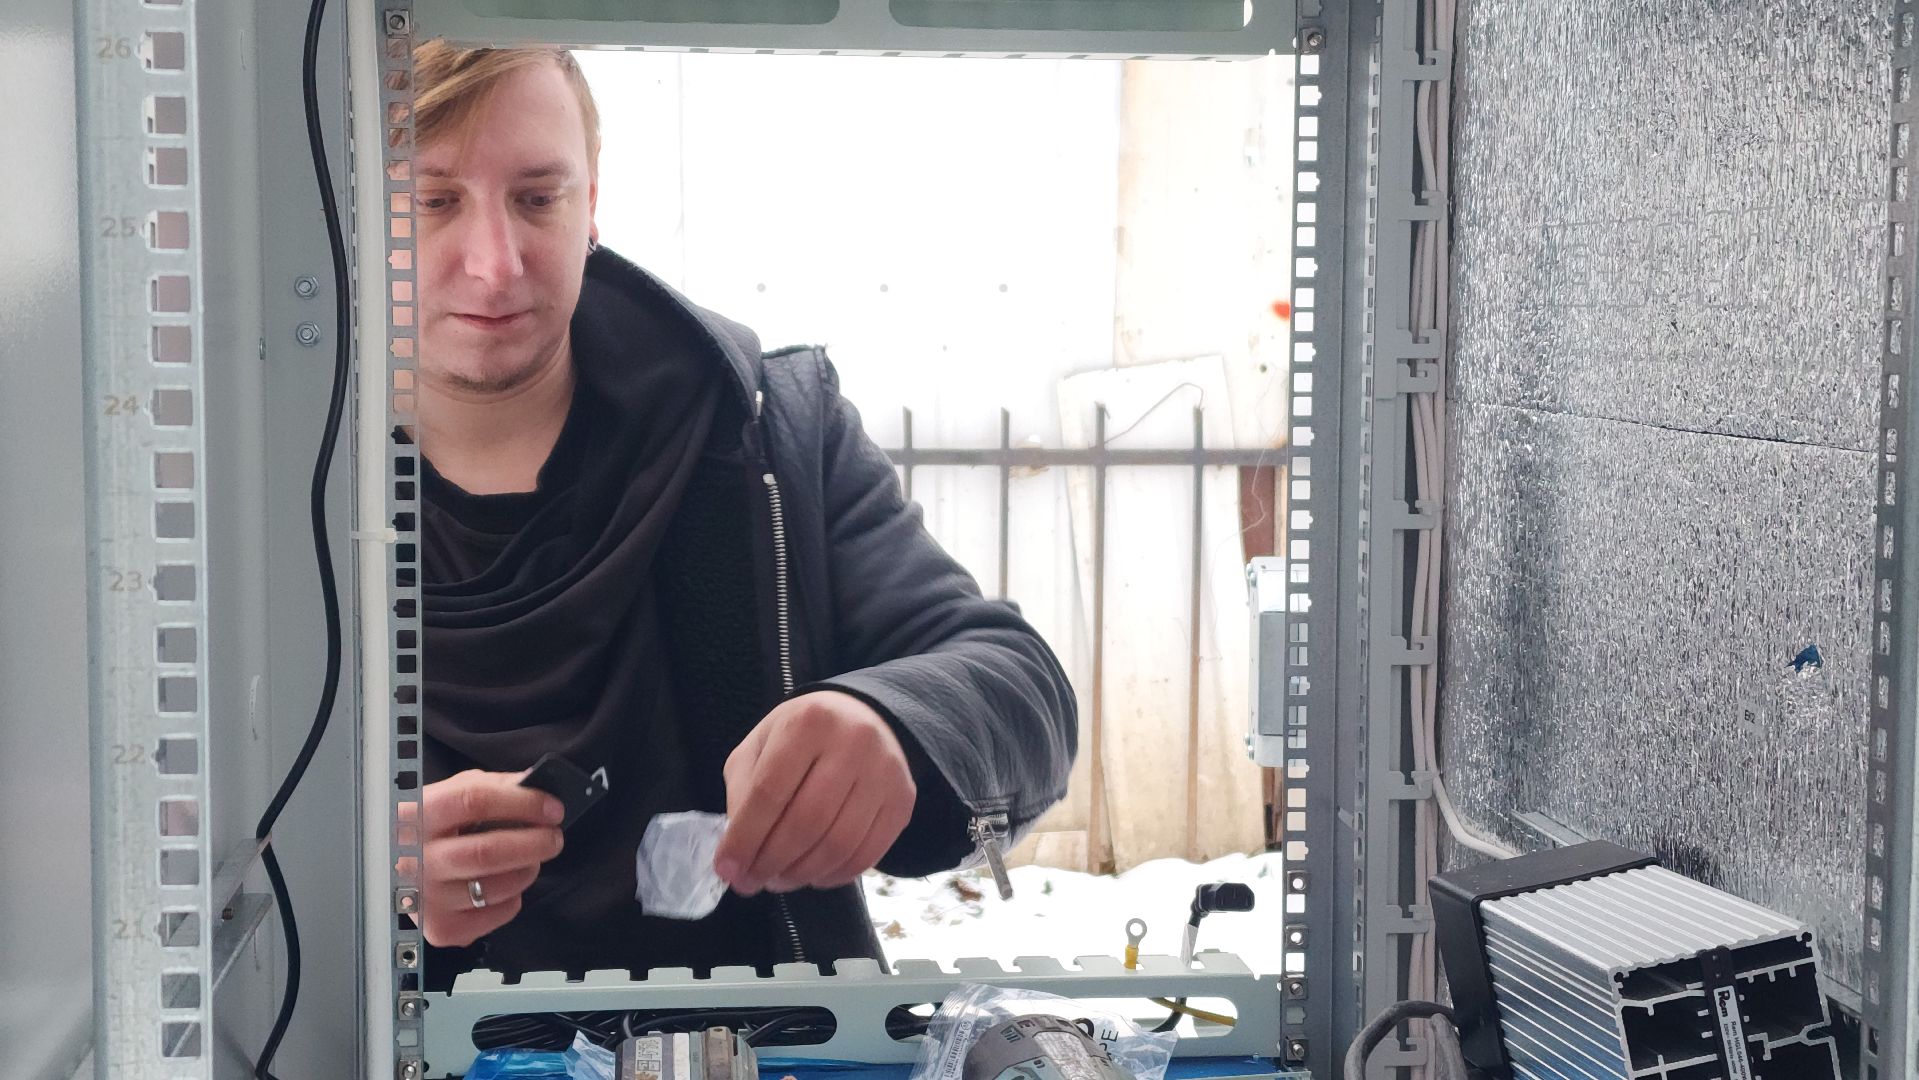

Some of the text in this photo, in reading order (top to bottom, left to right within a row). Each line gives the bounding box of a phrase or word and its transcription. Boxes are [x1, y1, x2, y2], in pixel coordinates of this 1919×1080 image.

[98, 36, 131, 59] 26
[101, 216, 136, 237] 25
[103, 395, 139, 416] 24
[110, 570, 142, 592] 23
[111, 744, 145, 764] 22
[111, 919, 145, 939] 21
[1717, 990, 1730, 1018] Rem
